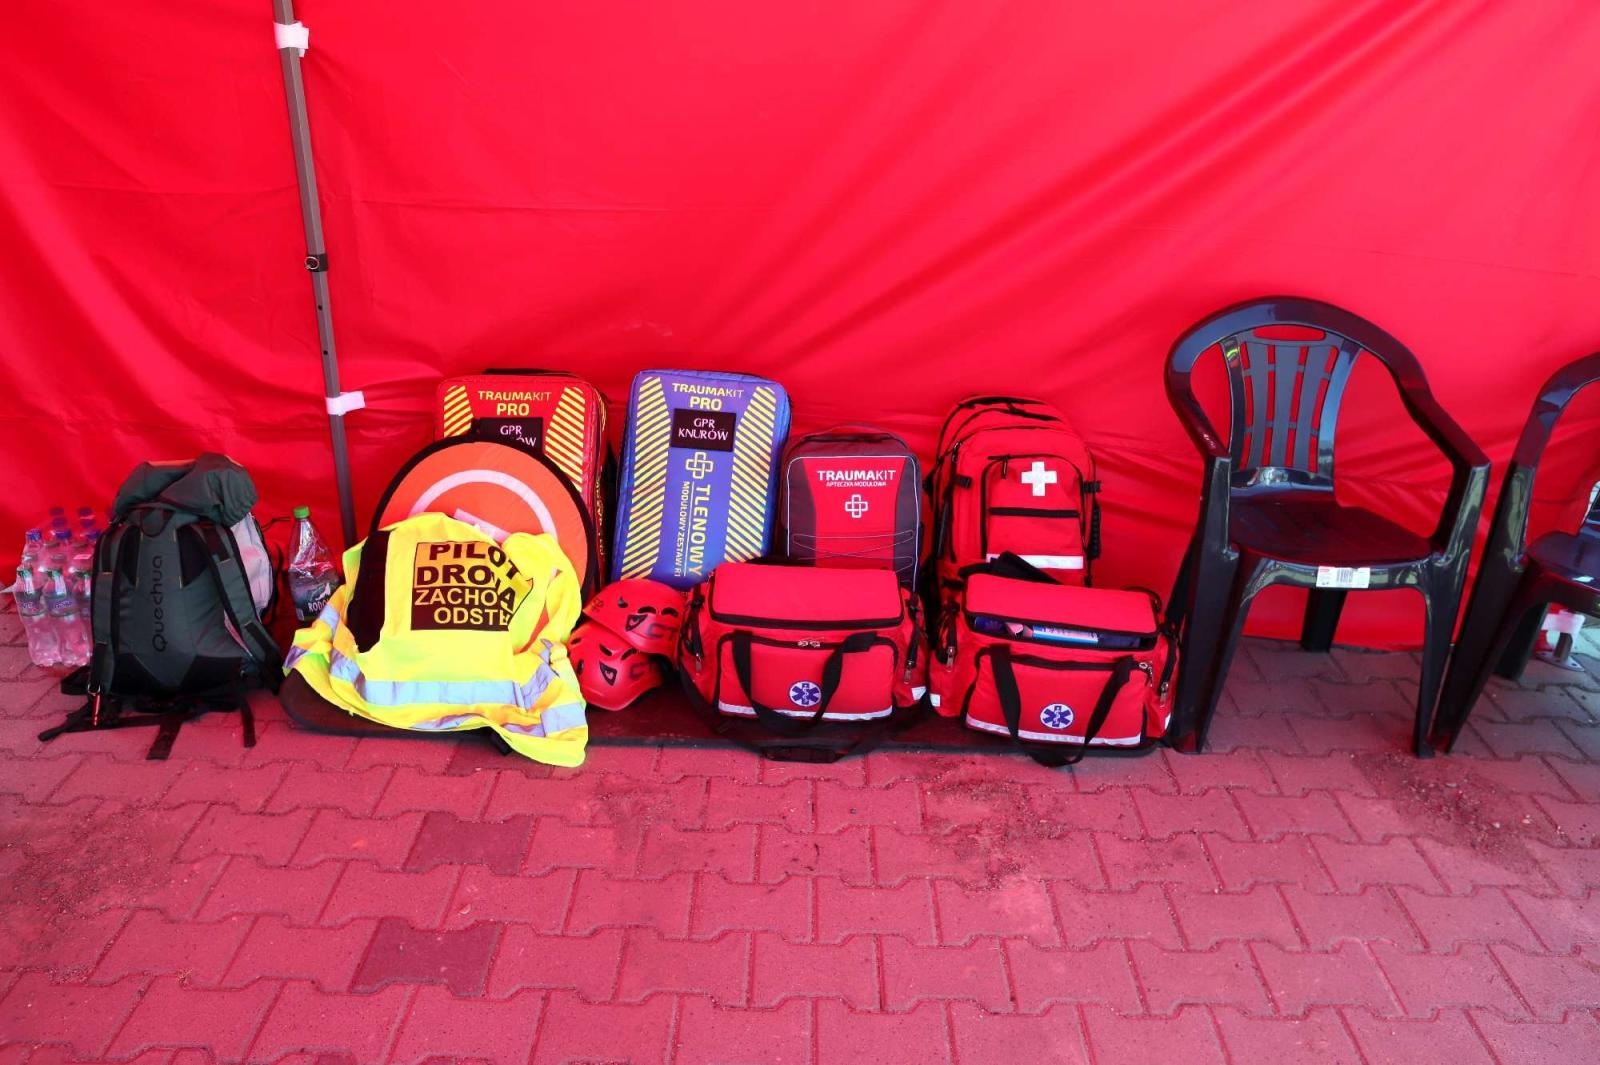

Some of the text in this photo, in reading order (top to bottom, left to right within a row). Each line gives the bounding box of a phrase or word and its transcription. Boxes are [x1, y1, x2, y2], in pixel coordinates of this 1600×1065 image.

[477, 391, 552, 401] TRAUMAKIT
[672, 383, 745, 398] TRAUMAKIT
[496, 403, 530, 416] PRO
[690, 396, 723, 411] PRO
[693, 418, 716, 428] GPR
[500, 425, 522, 436] GPR
[678, 428, 729, 441] KNURÓW
[817, 470, 897, 481] TRAUMAKIT
[688, 484, 711, 577] TLENOWY
[150, 555, 168, 653] Quechua
